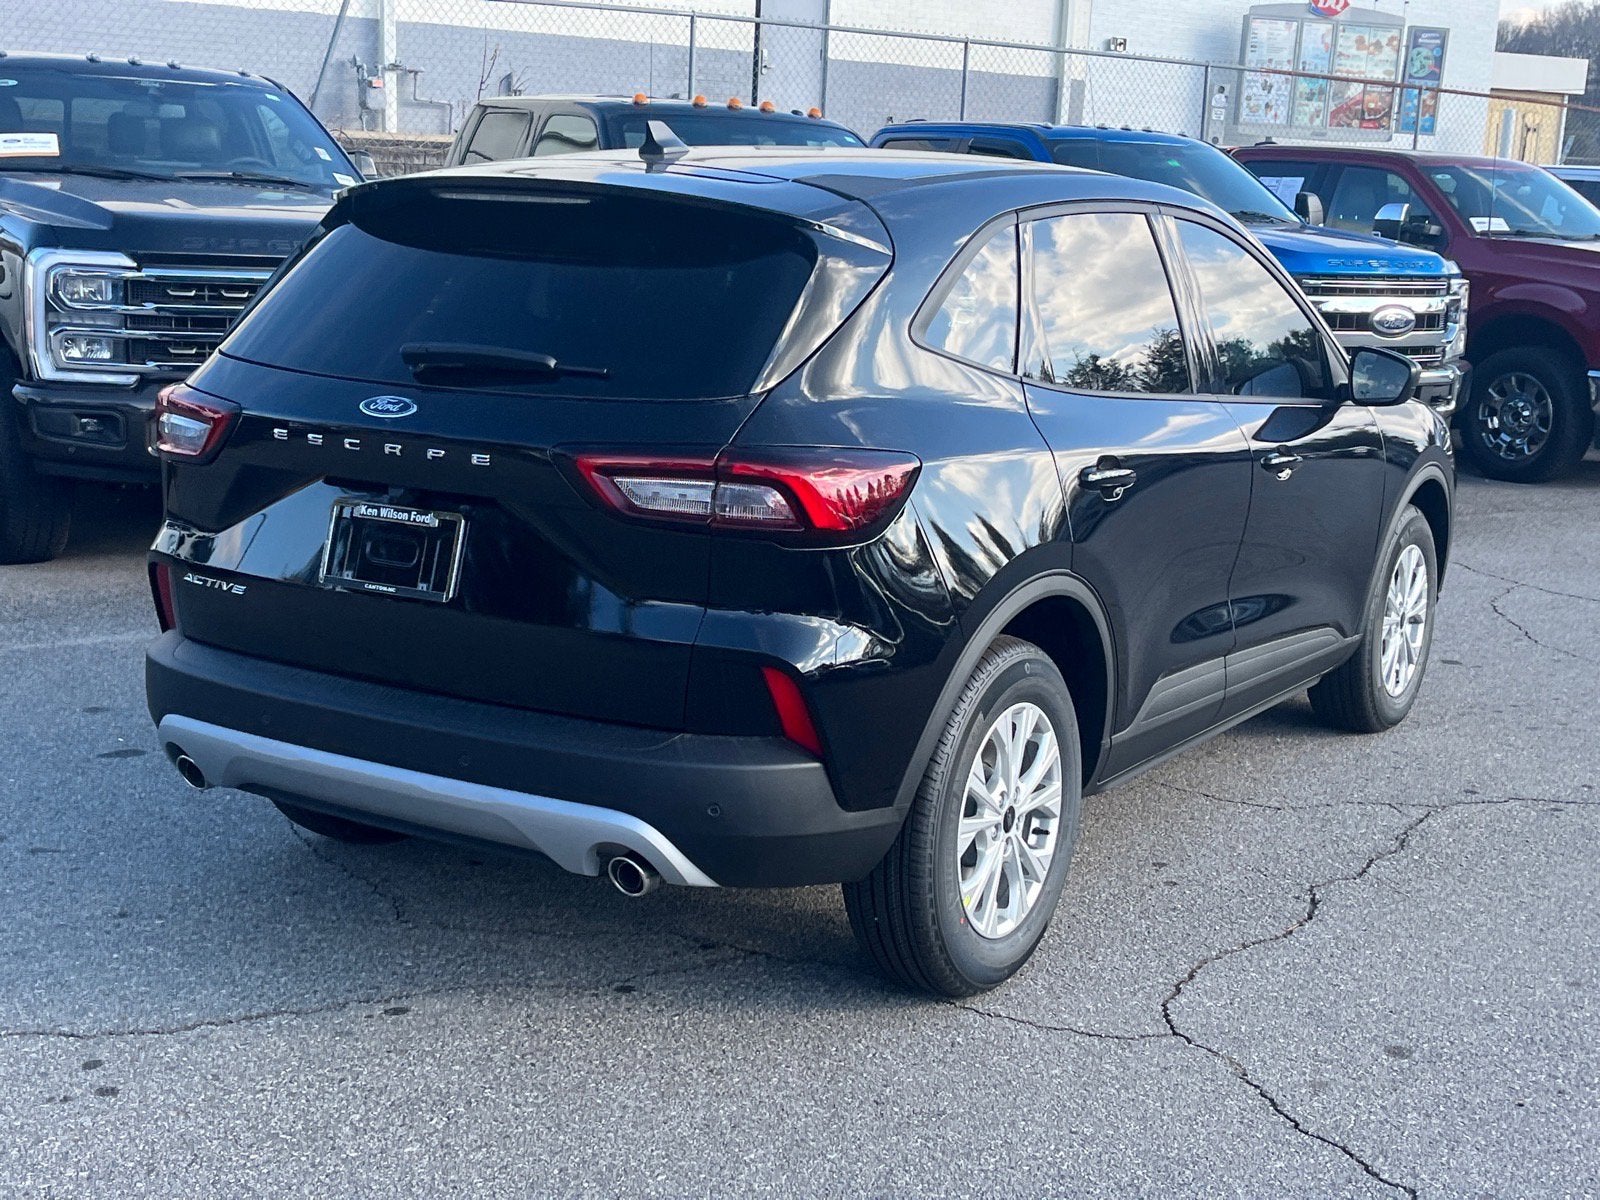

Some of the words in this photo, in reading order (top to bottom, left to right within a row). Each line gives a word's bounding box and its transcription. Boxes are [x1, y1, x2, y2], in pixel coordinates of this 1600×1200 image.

[1327, 258, 1391, 269] SUPER
[1395, 260, 1435, 270] DUTY
[369, 397, 404, 412] Ford
[273, 427, 491, 466] ESCAPE
[360, 504, 378, 517] Ken
[380, 507, 409, 521] Wilson
[410, 511, 431, 524] Ford
[183, 572, 247, 595] ACTIVE
